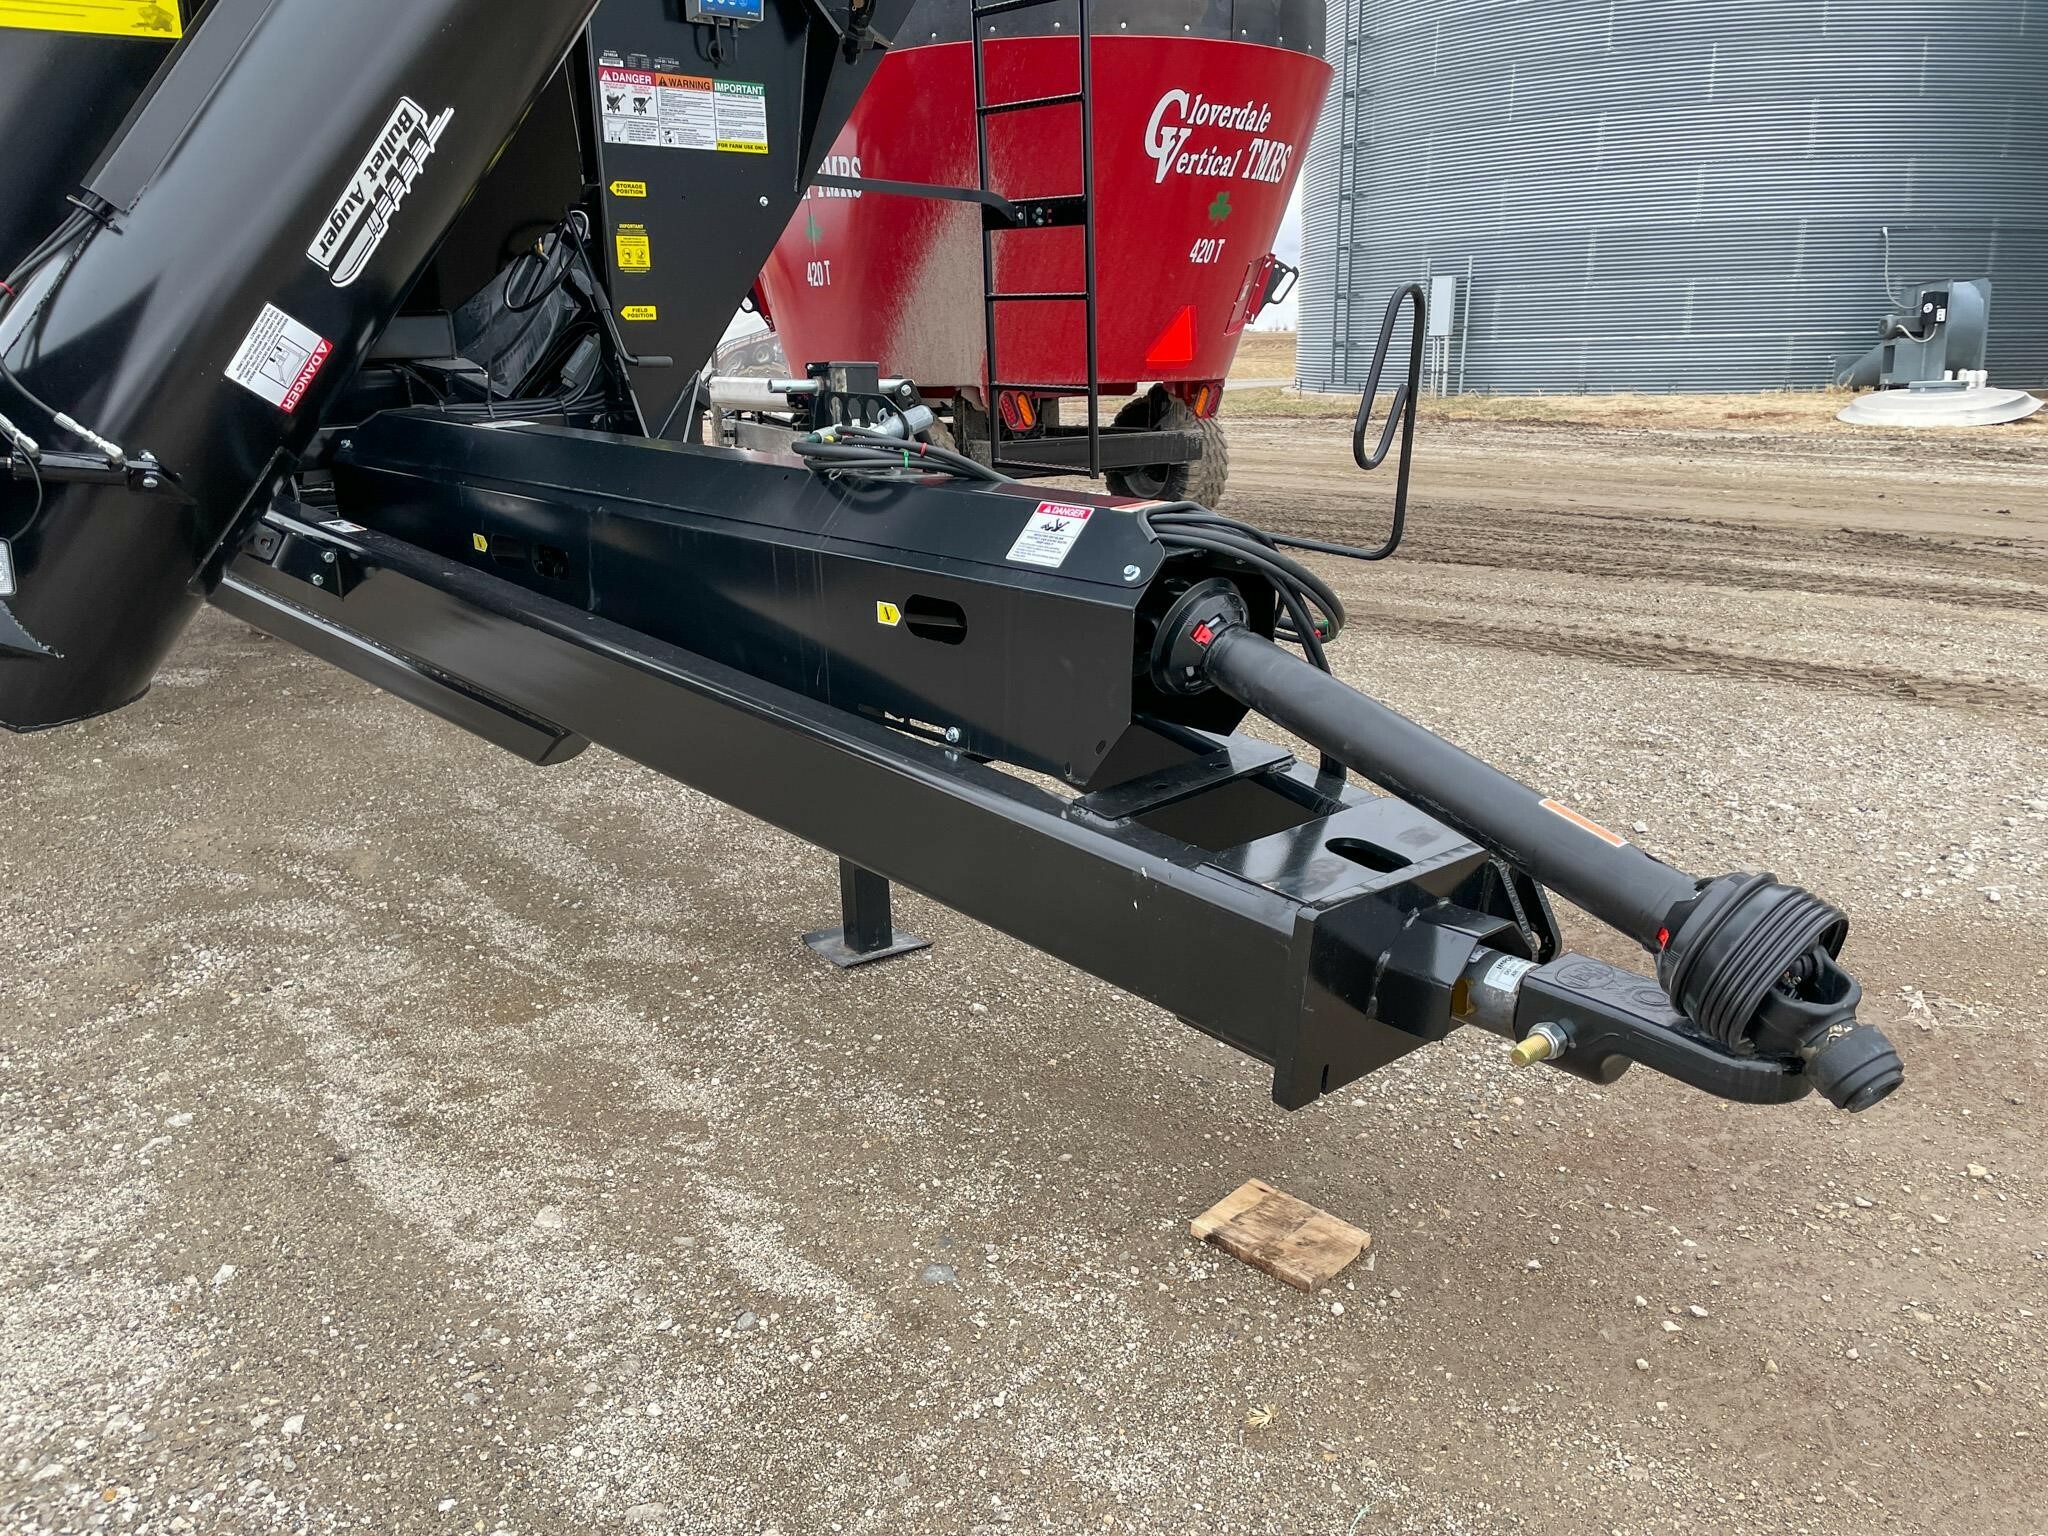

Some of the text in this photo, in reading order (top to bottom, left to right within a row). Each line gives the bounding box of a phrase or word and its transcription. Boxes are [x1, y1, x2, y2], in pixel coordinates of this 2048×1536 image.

[612, 72, 652, 84] DANGER
[668, 78, 711, 90] WARNING
[714, 82, 764, 95] IMPORTANT
[1144, 88, 1272, 158] Cloverdale
[1155, 126, 1293, 184] Vertical TMRS
[319, 108, 414, 257] Bullet Auger
[1189, 238, 1226, 264] 420 T
[807, 260, 831, 287] 420 T
[284, 354, 322, 411] DANGER
[1051, 507, 1086, 518] DANGER
